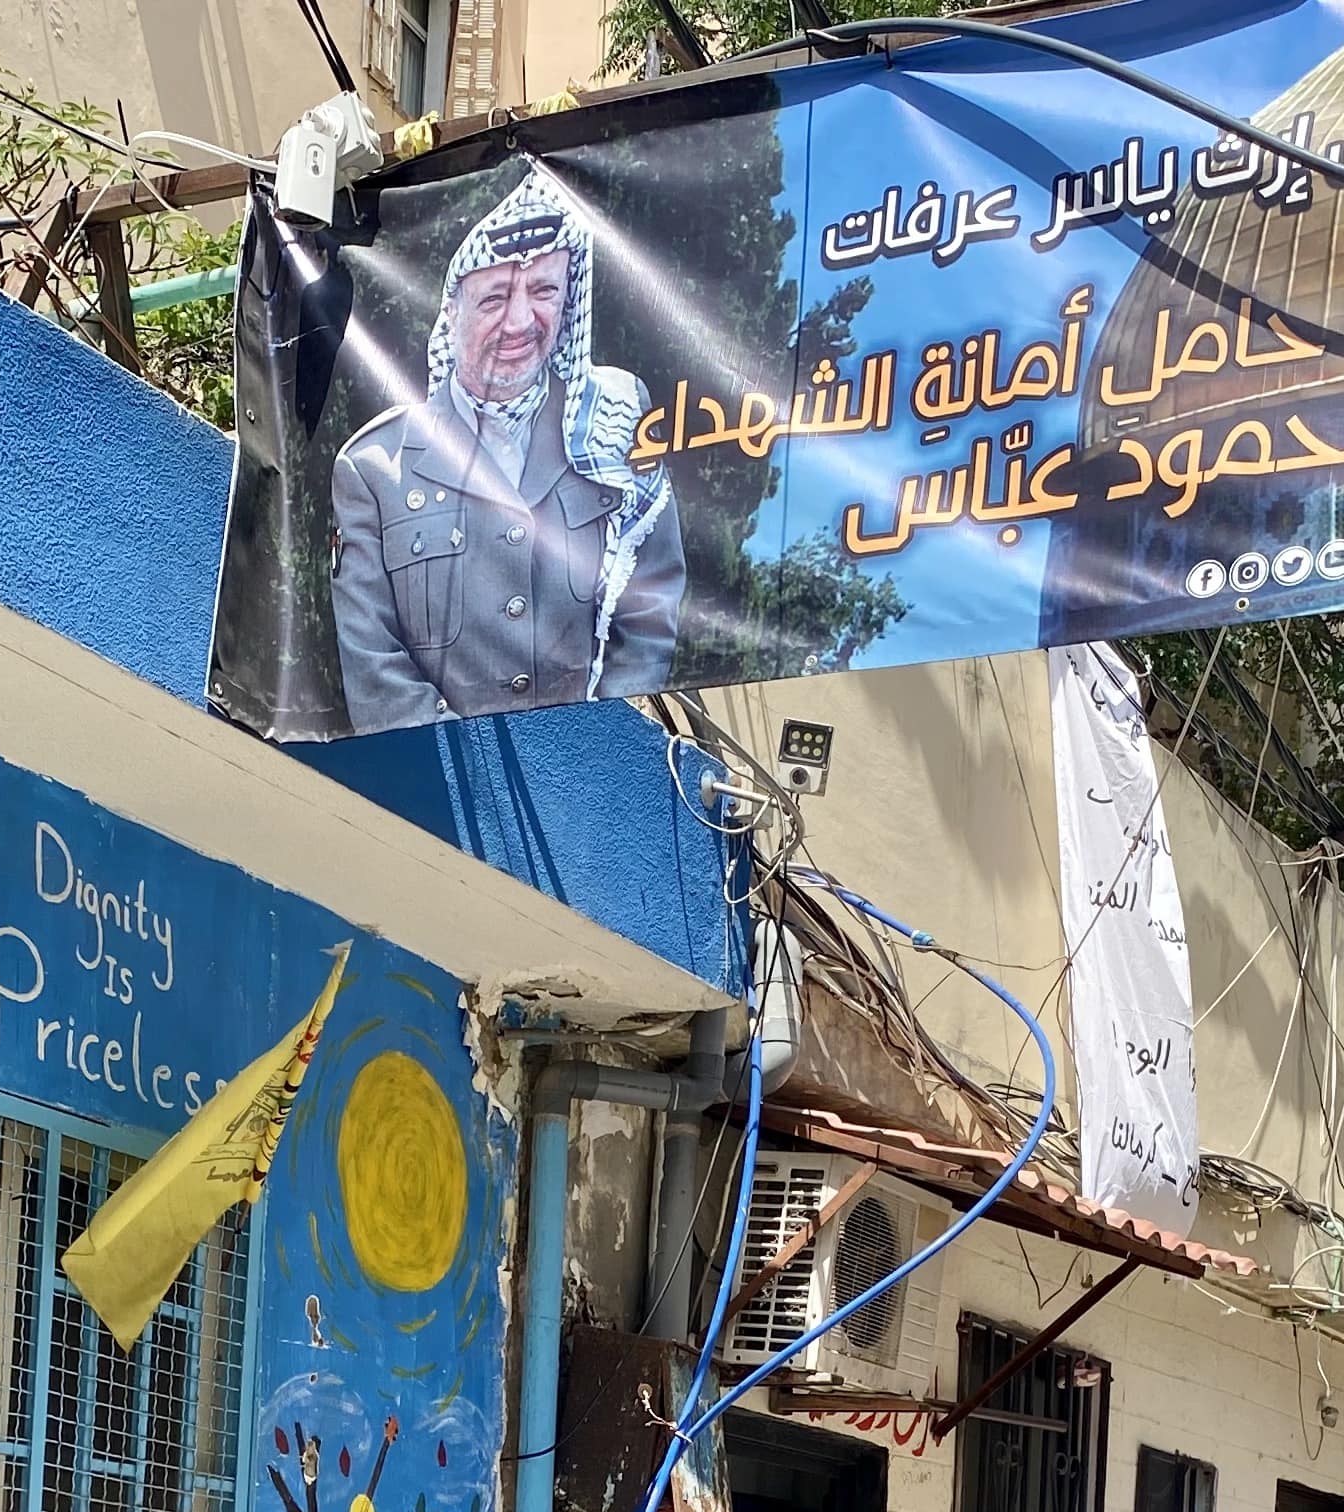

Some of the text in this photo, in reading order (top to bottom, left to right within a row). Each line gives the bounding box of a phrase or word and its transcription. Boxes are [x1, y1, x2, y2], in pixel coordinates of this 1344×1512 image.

[823, 180, 1020, 262] عرفات
[1034, 140, 1176, 246] ياسر
[35, 820, 174, 991] Dignity
[104, 954, 134, 1005] Is
